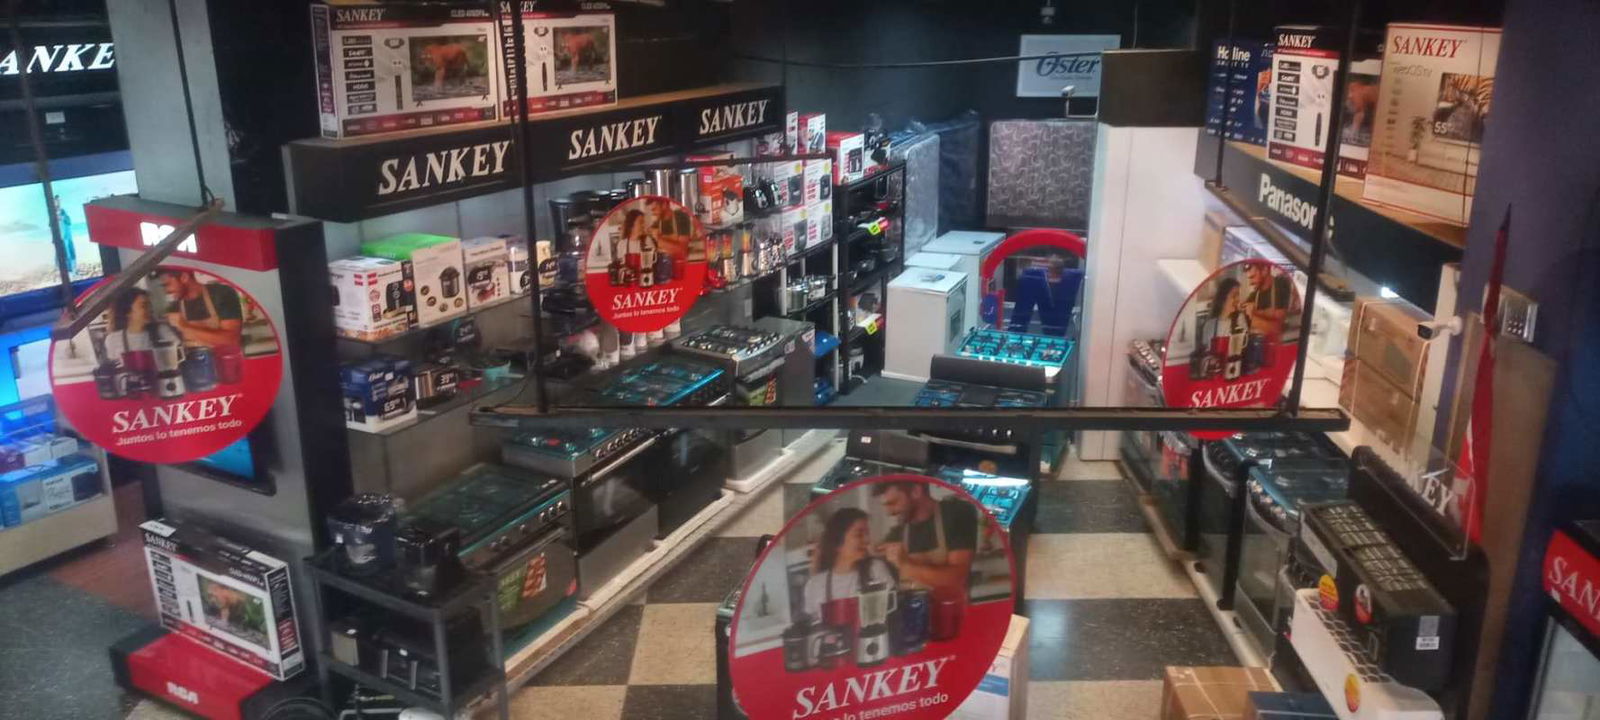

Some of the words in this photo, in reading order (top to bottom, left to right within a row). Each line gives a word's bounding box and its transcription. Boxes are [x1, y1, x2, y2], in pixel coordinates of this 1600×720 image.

[336, 8, 384, 22] SANKEY
[1217, 46, 1250, 61] Holine
[1278, 34, 1315, 48] SANKEY
[1392, 35, 1462, 58] SANKEY
[1036, 51, 1099, 77] Oster
[700, 100, 768, 134] SANKEY
[569, 117, 659, 159] SANKEY
[377, 141, 509, 195] SANKEY
[612, 288, 678, 310] SANKEY
[1189, 378, 1269, 408] SANKEY
[112, 395, 238, 433] SANKEY
[116, 435, 154, 446] Juntos
[156, 431, 167, 440] lo
[168, 424, 216, 438] tenemos
[217, 419, 242, 430] todo
[1548, 555, 1600, 622] SAN
[166, 681, 199, 705] RCA
[793, 658, 948, 719] SANKEY
[859, 700, 917, 720] tenemos
[920, 693, 949, 707] todo
